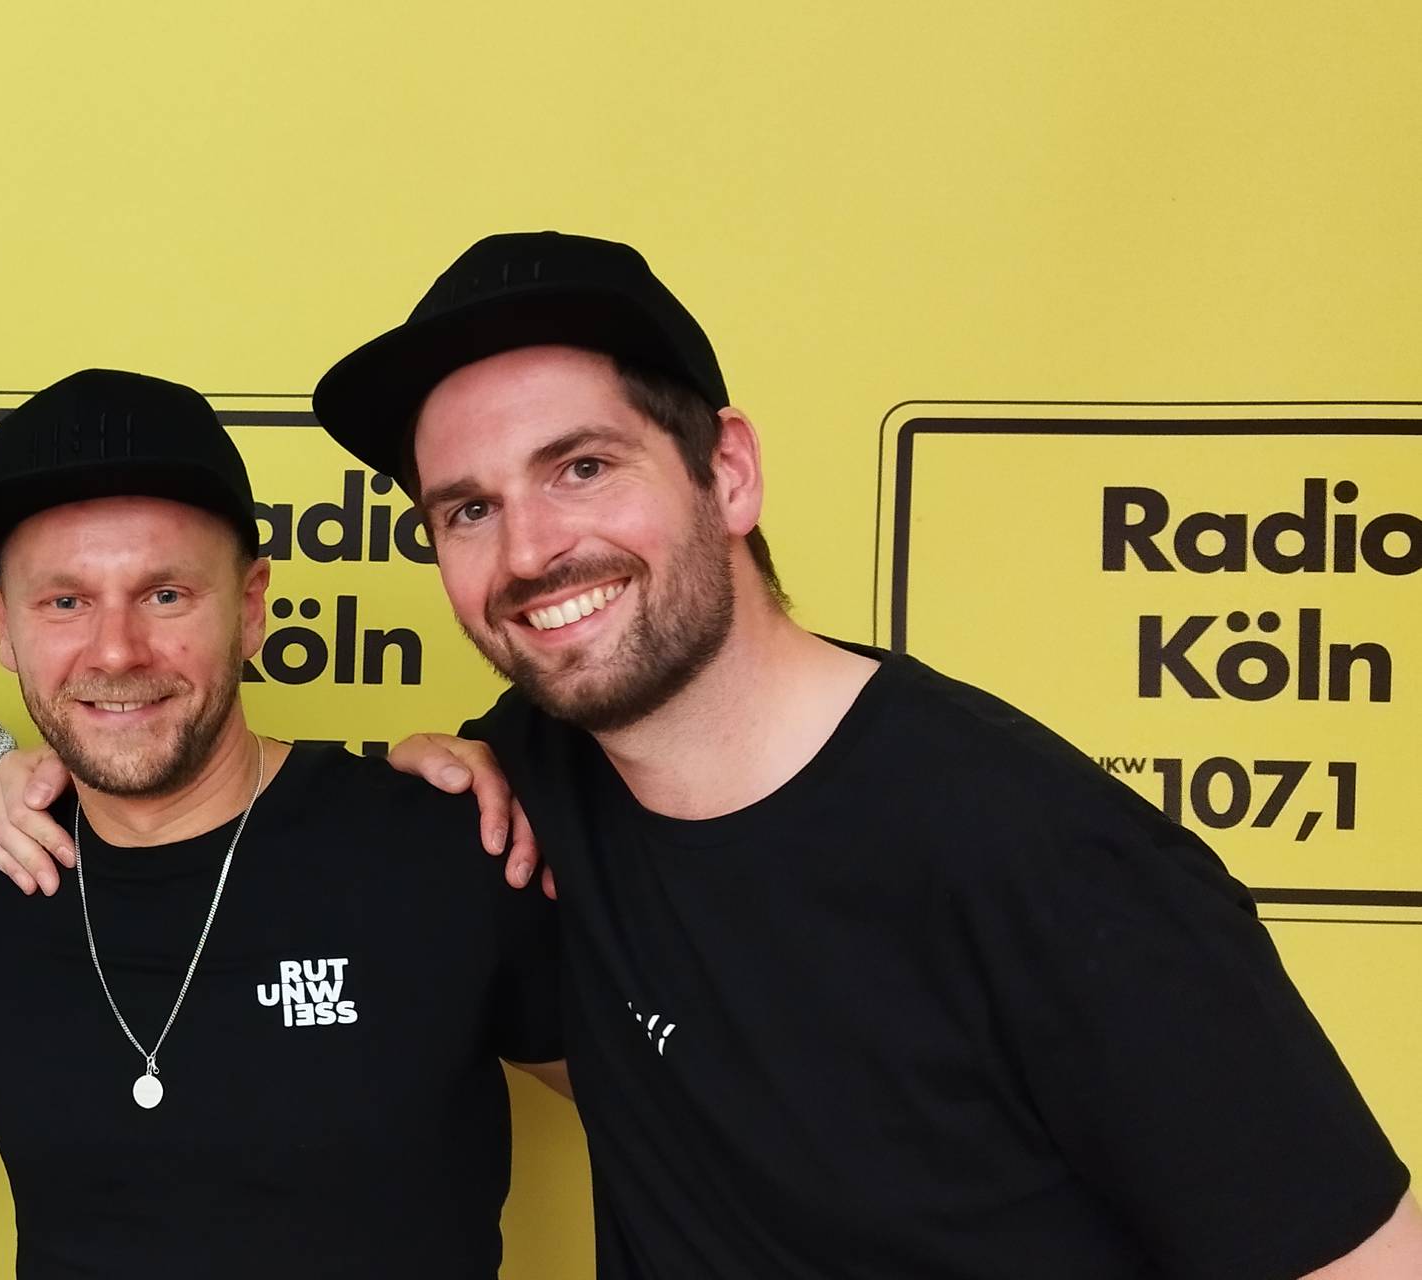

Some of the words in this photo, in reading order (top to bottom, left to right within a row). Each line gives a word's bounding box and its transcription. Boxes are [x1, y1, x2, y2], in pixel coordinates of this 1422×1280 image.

[253, 470, 438, 564] adio
[1102, 478, 1422, 575] Radio
[242, 595, 422, 685] öln
[1138, 608, 1392, 702] Köln
[1153, 756, 1357, 841] 107,1
[257, 980, 343, 1006] UNW
[280, 958, 348, 983] RUT
